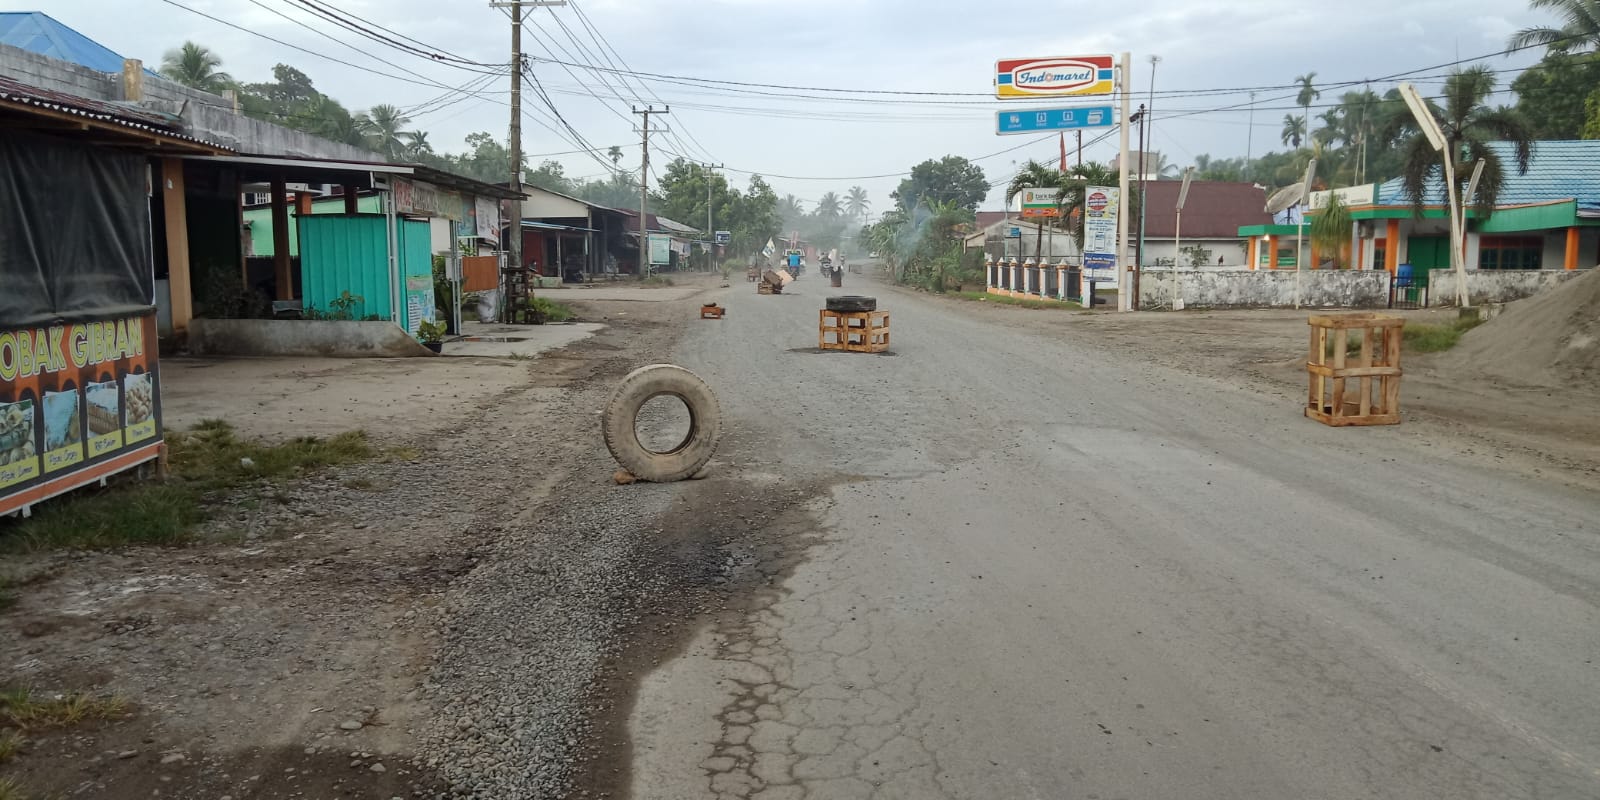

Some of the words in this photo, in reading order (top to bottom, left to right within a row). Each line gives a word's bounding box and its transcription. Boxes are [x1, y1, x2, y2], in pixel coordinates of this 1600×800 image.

[1019, 70, 1091, 84] Indomaret
[0, 326, 66, 382] OBAK
[70, 317, 143, 368] GIBRAN
